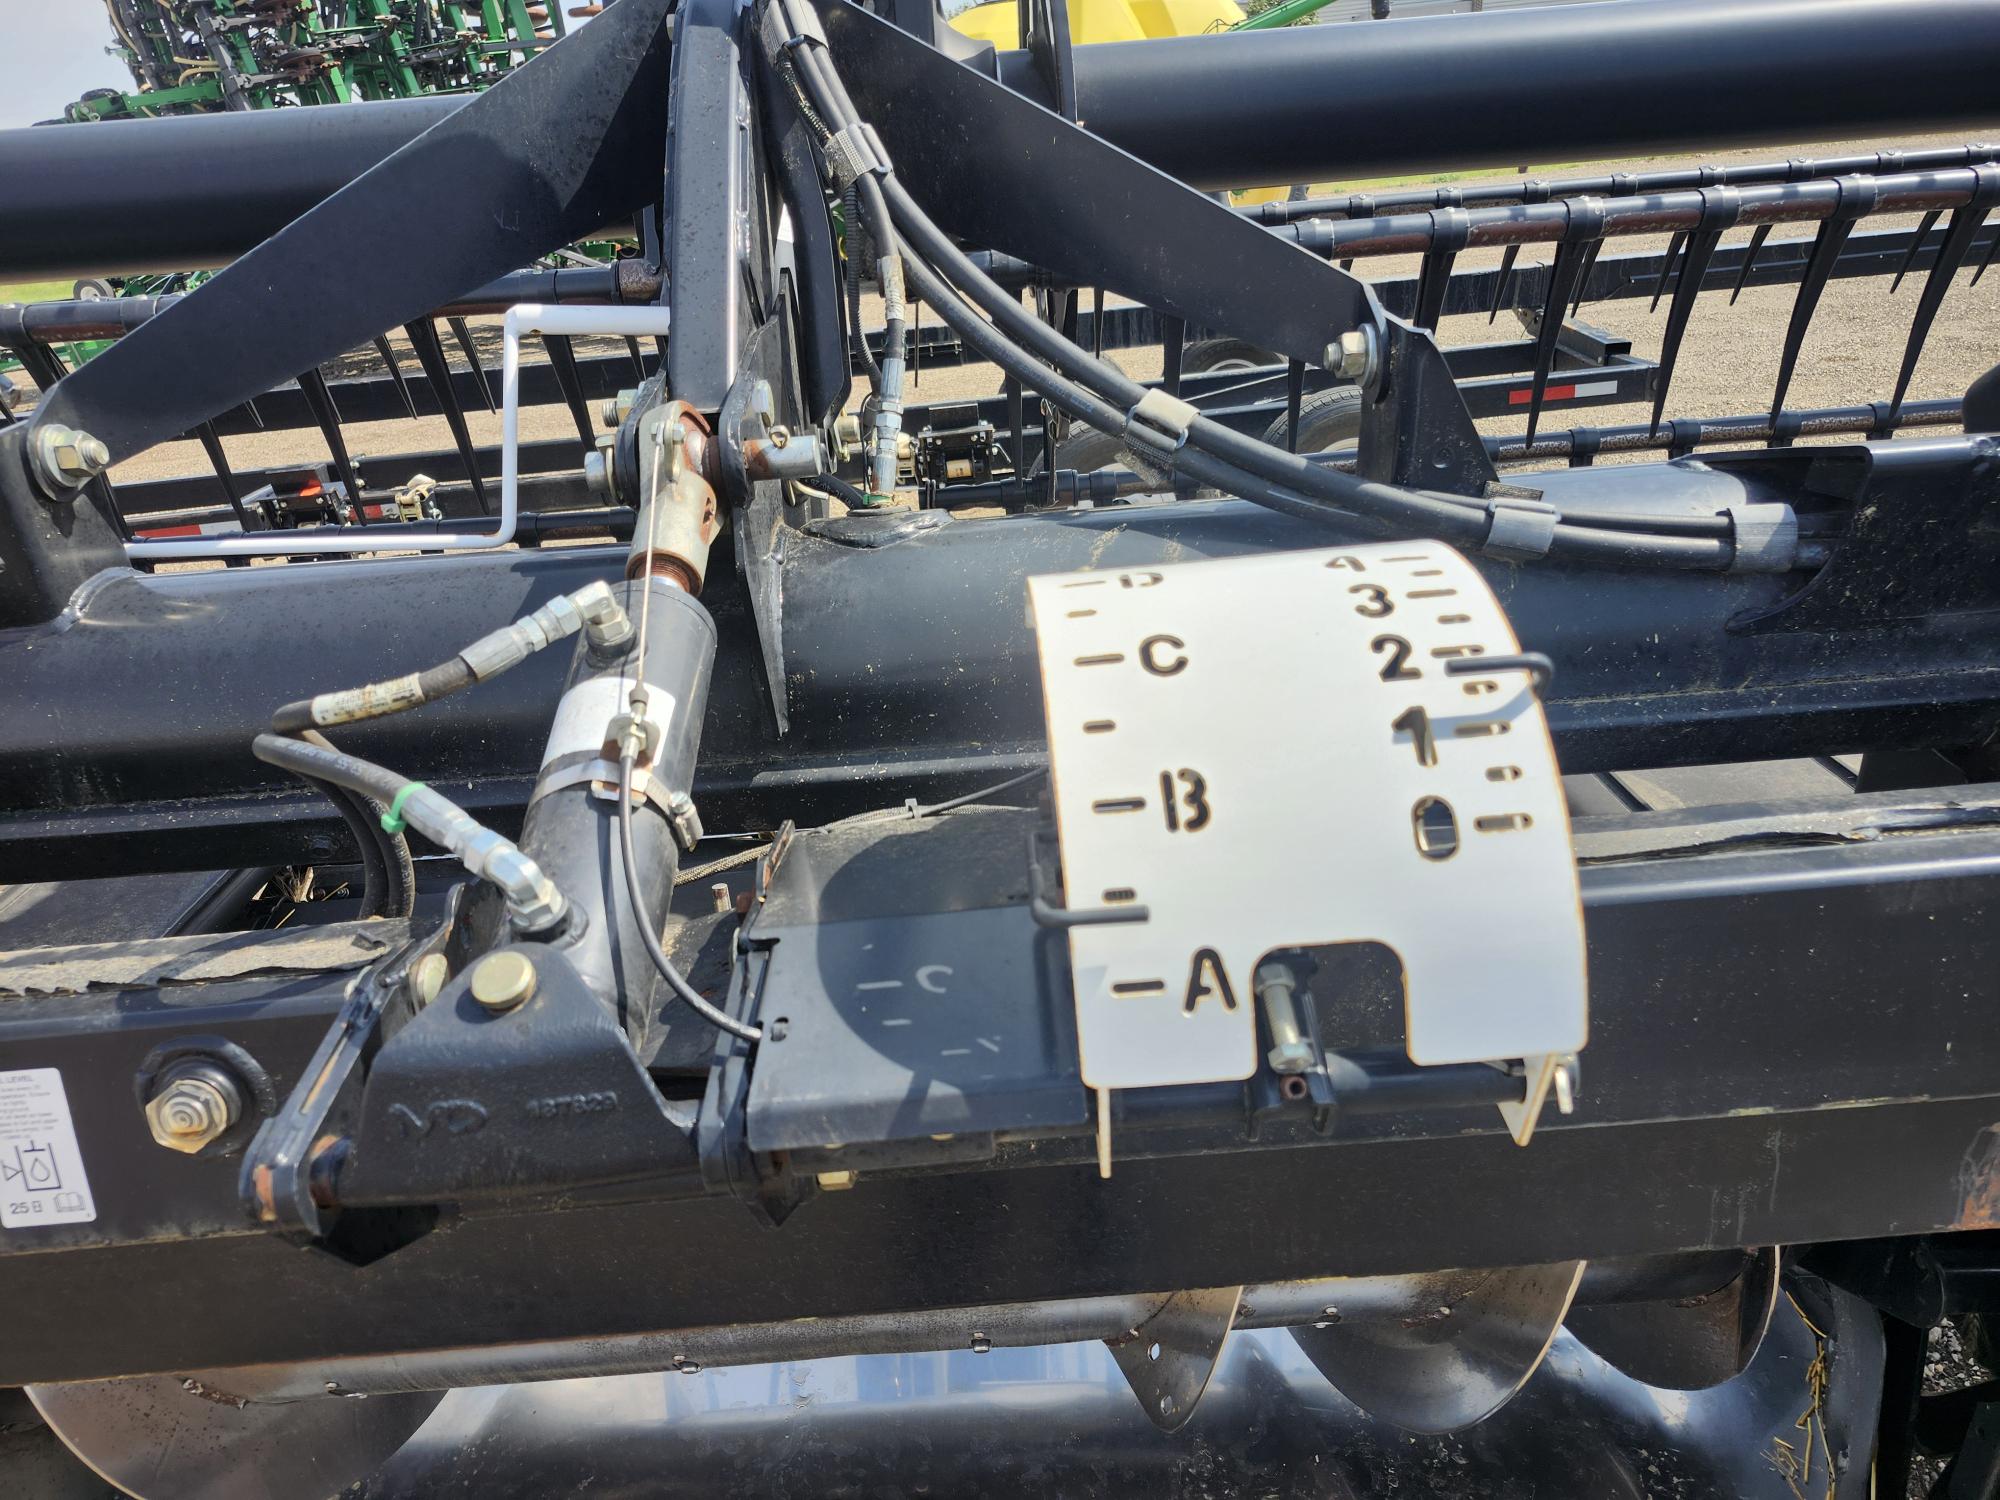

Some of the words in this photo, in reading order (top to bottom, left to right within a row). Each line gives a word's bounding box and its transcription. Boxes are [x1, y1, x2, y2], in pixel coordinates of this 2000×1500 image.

[1348, 583, 1395, 618] 3
[1138, 635, 1189, 677] C
[1371, 635, 1422, 682] 2
[1392, 706, 1438, 767] 1
[1158, 768, 1212, 833] B
[1183, 946, 1238, 1013] A
[10, 1202, 30, 1214] 25
